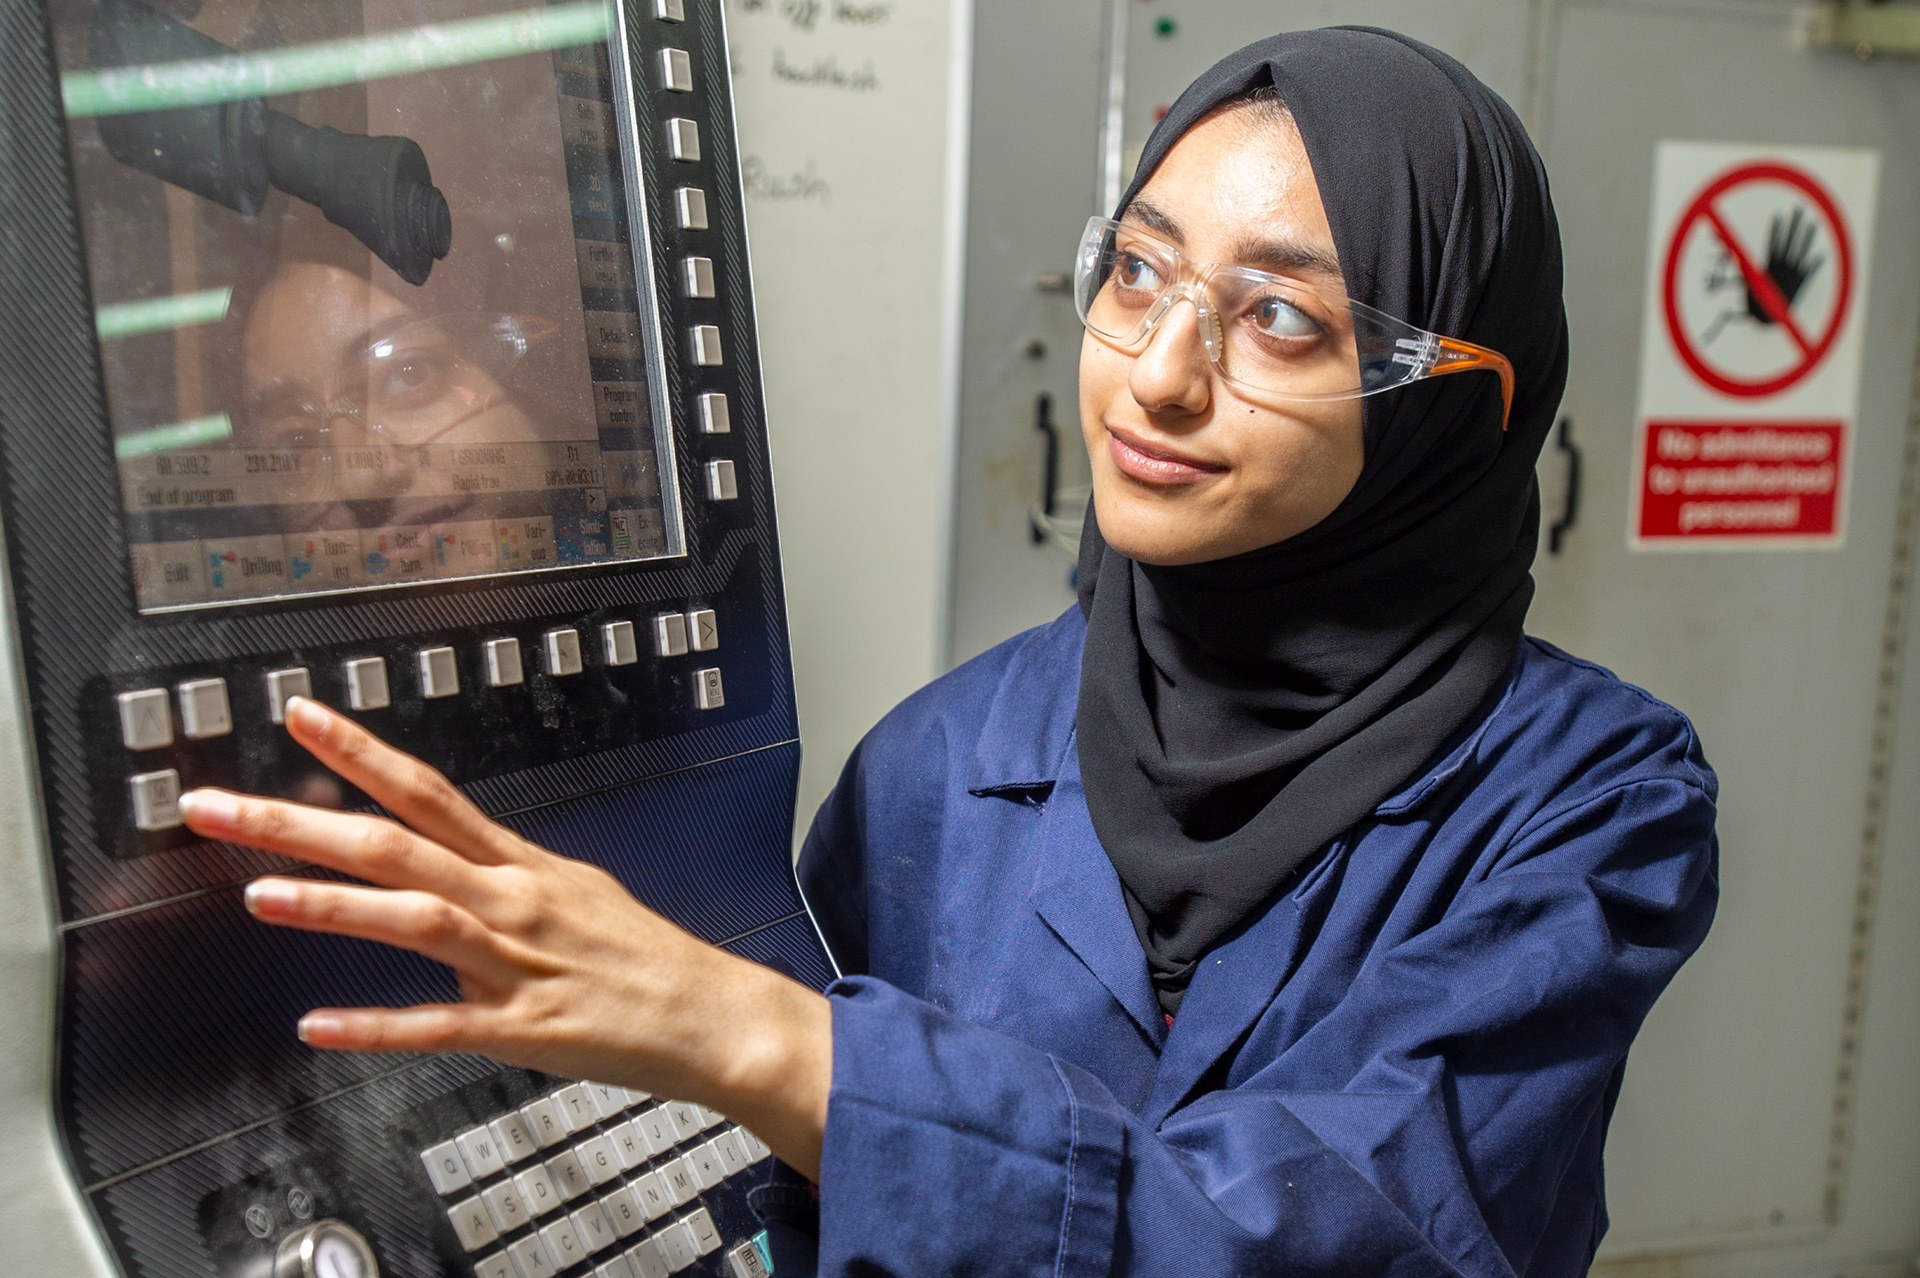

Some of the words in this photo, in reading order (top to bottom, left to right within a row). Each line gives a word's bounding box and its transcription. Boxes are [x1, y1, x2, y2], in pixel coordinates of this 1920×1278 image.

[600, 327, 627, 343] Details
[604, 386, 638, 403] Program
[609, 408, 637, 423] control
[182, 487, 234, 506] program
[524, 521, 546, 539] Vari-
[530, 548, 546, 561] ous
[241, 556, 283, 577] Drilling
